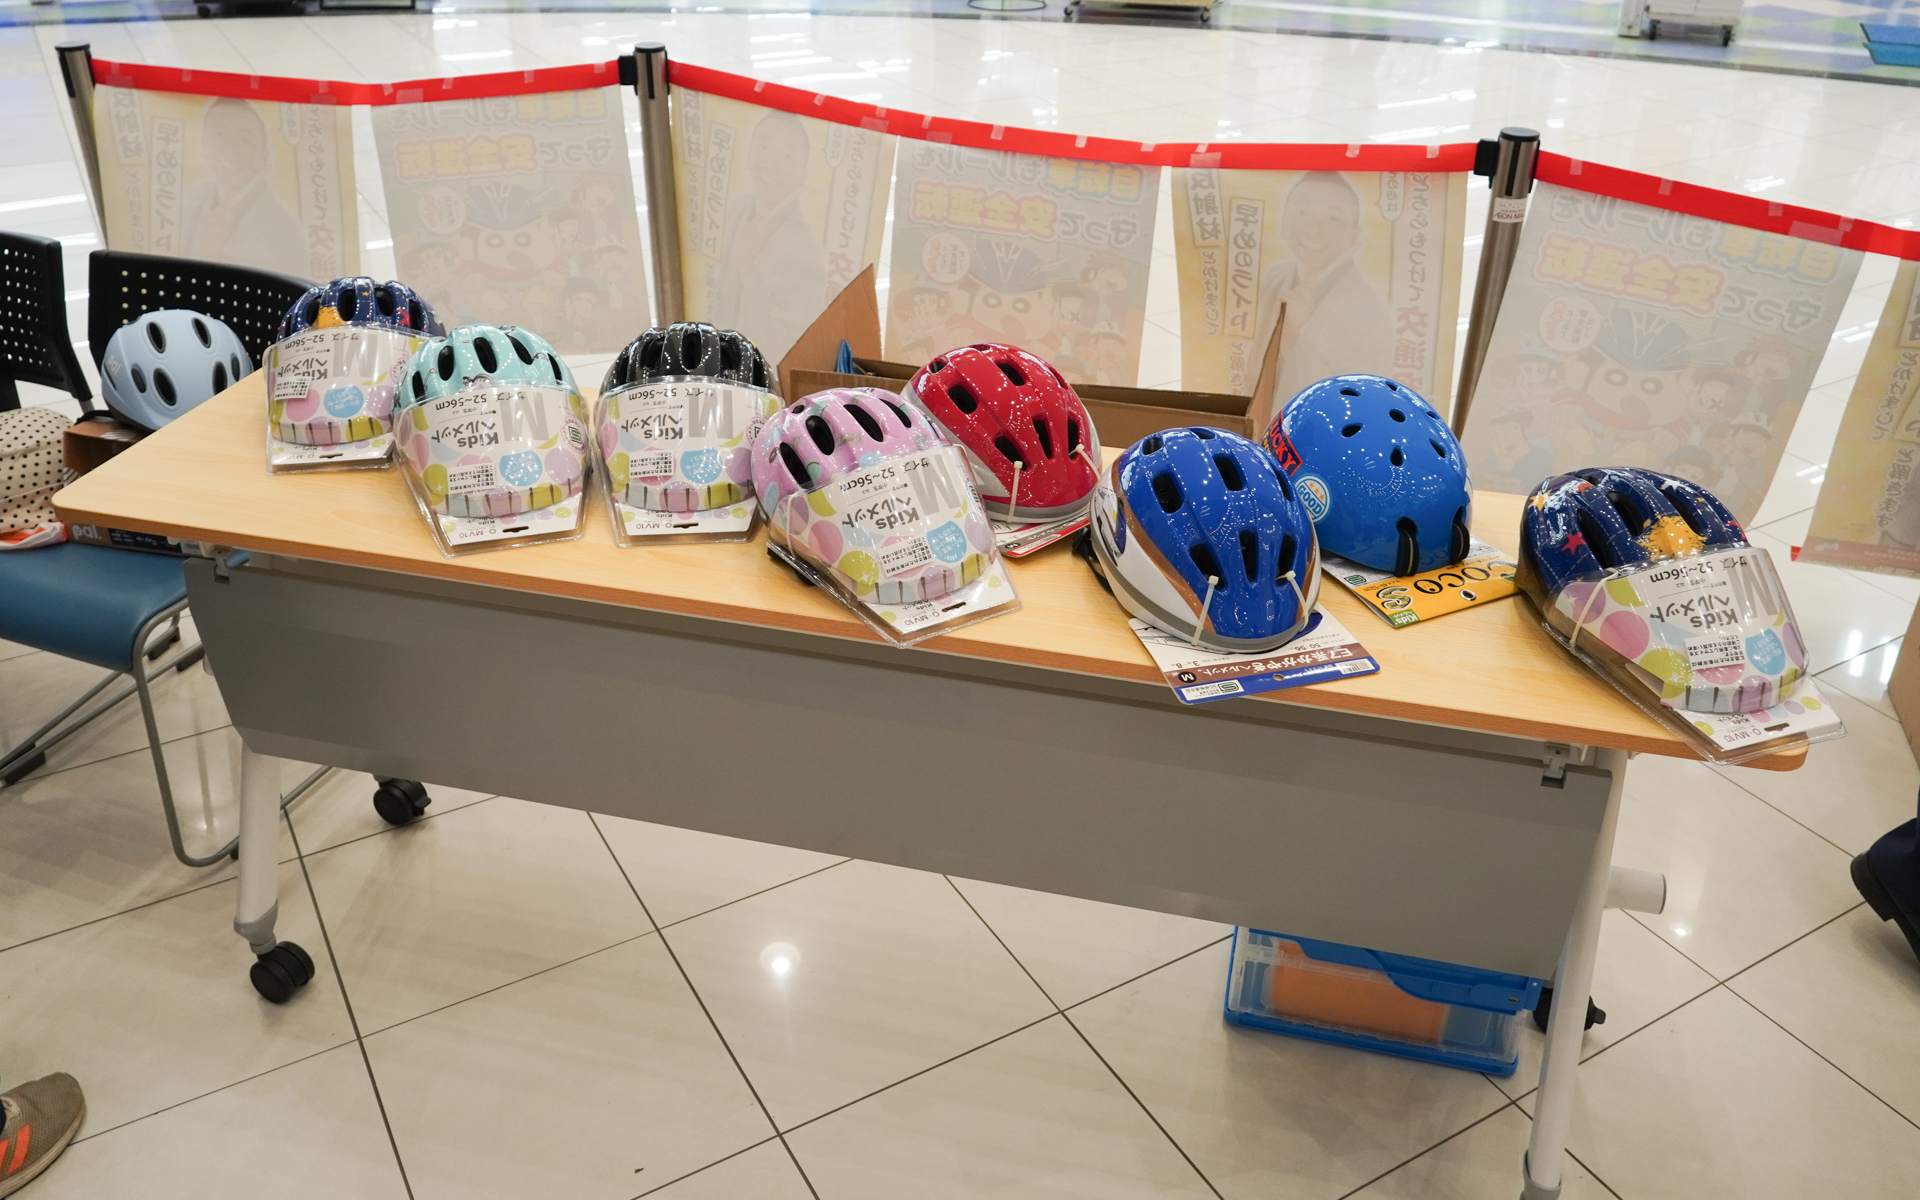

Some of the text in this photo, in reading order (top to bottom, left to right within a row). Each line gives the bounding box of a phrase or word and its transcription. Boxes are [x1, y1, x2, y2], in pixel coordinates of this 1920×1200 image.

[331, 333, 359, 341] サイズ
[278, 358, 328, 377] ヘルメット
[431, 420, 495, 443] ヘルメット
[621, 414, 683, 433] ヘルメット
[457, 432, 499, 449] Kids
[644, 427, 683, 441] Kids
[902, 458, 930, 472] サイズ
[873, 483, 888, 492] 小学生
[1298, 484, 1323, 515] GOOD
[842, 496, 911, 528] ヘルメット
[875, 507, 920, 530] Kids
[1721, 556, 1749, 570] サイズ
[1651, 594, 1731, 624] ヘルメット
[1691, 609, 1739, 629] Kids
